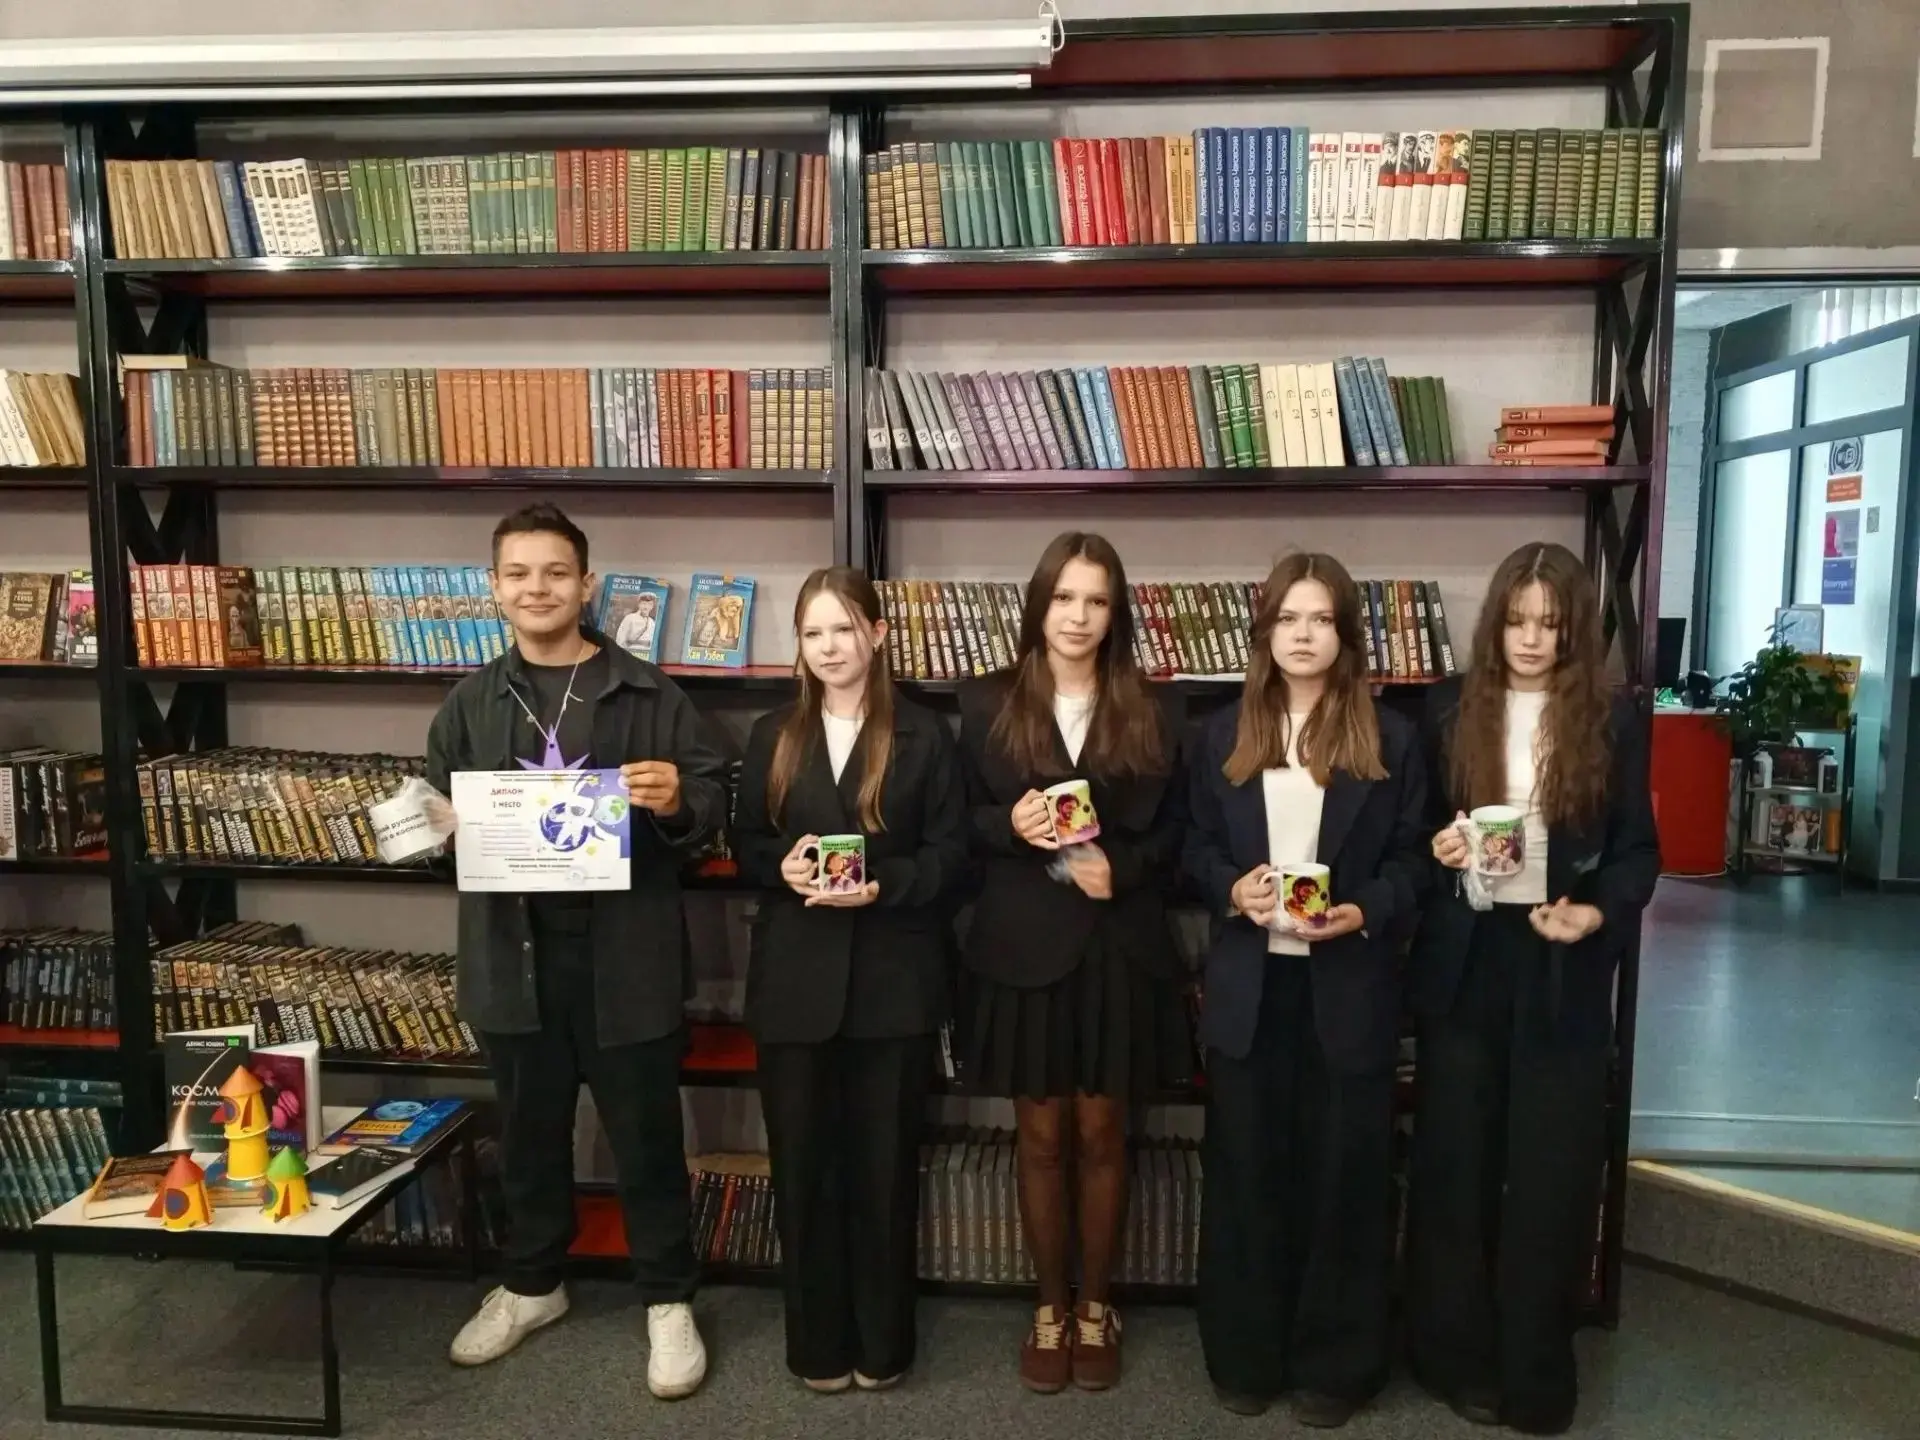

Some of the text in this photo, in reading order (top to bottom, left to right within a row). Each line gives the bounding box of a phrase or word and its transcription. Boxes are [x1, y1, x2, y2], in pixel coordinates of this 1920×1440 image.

[1072, 143, 1084, 157] 2
[1292, 409, 1300, 419] 2
[1311, 409, 1318, 418] 3
[873, 434, 883, 443] 1
[899, 434, 909, 443] 2
[920, 433, 928, 443] 3
[950, 434, 958, 443] 6
[172, 1085, 219, 1096] КОСМ
